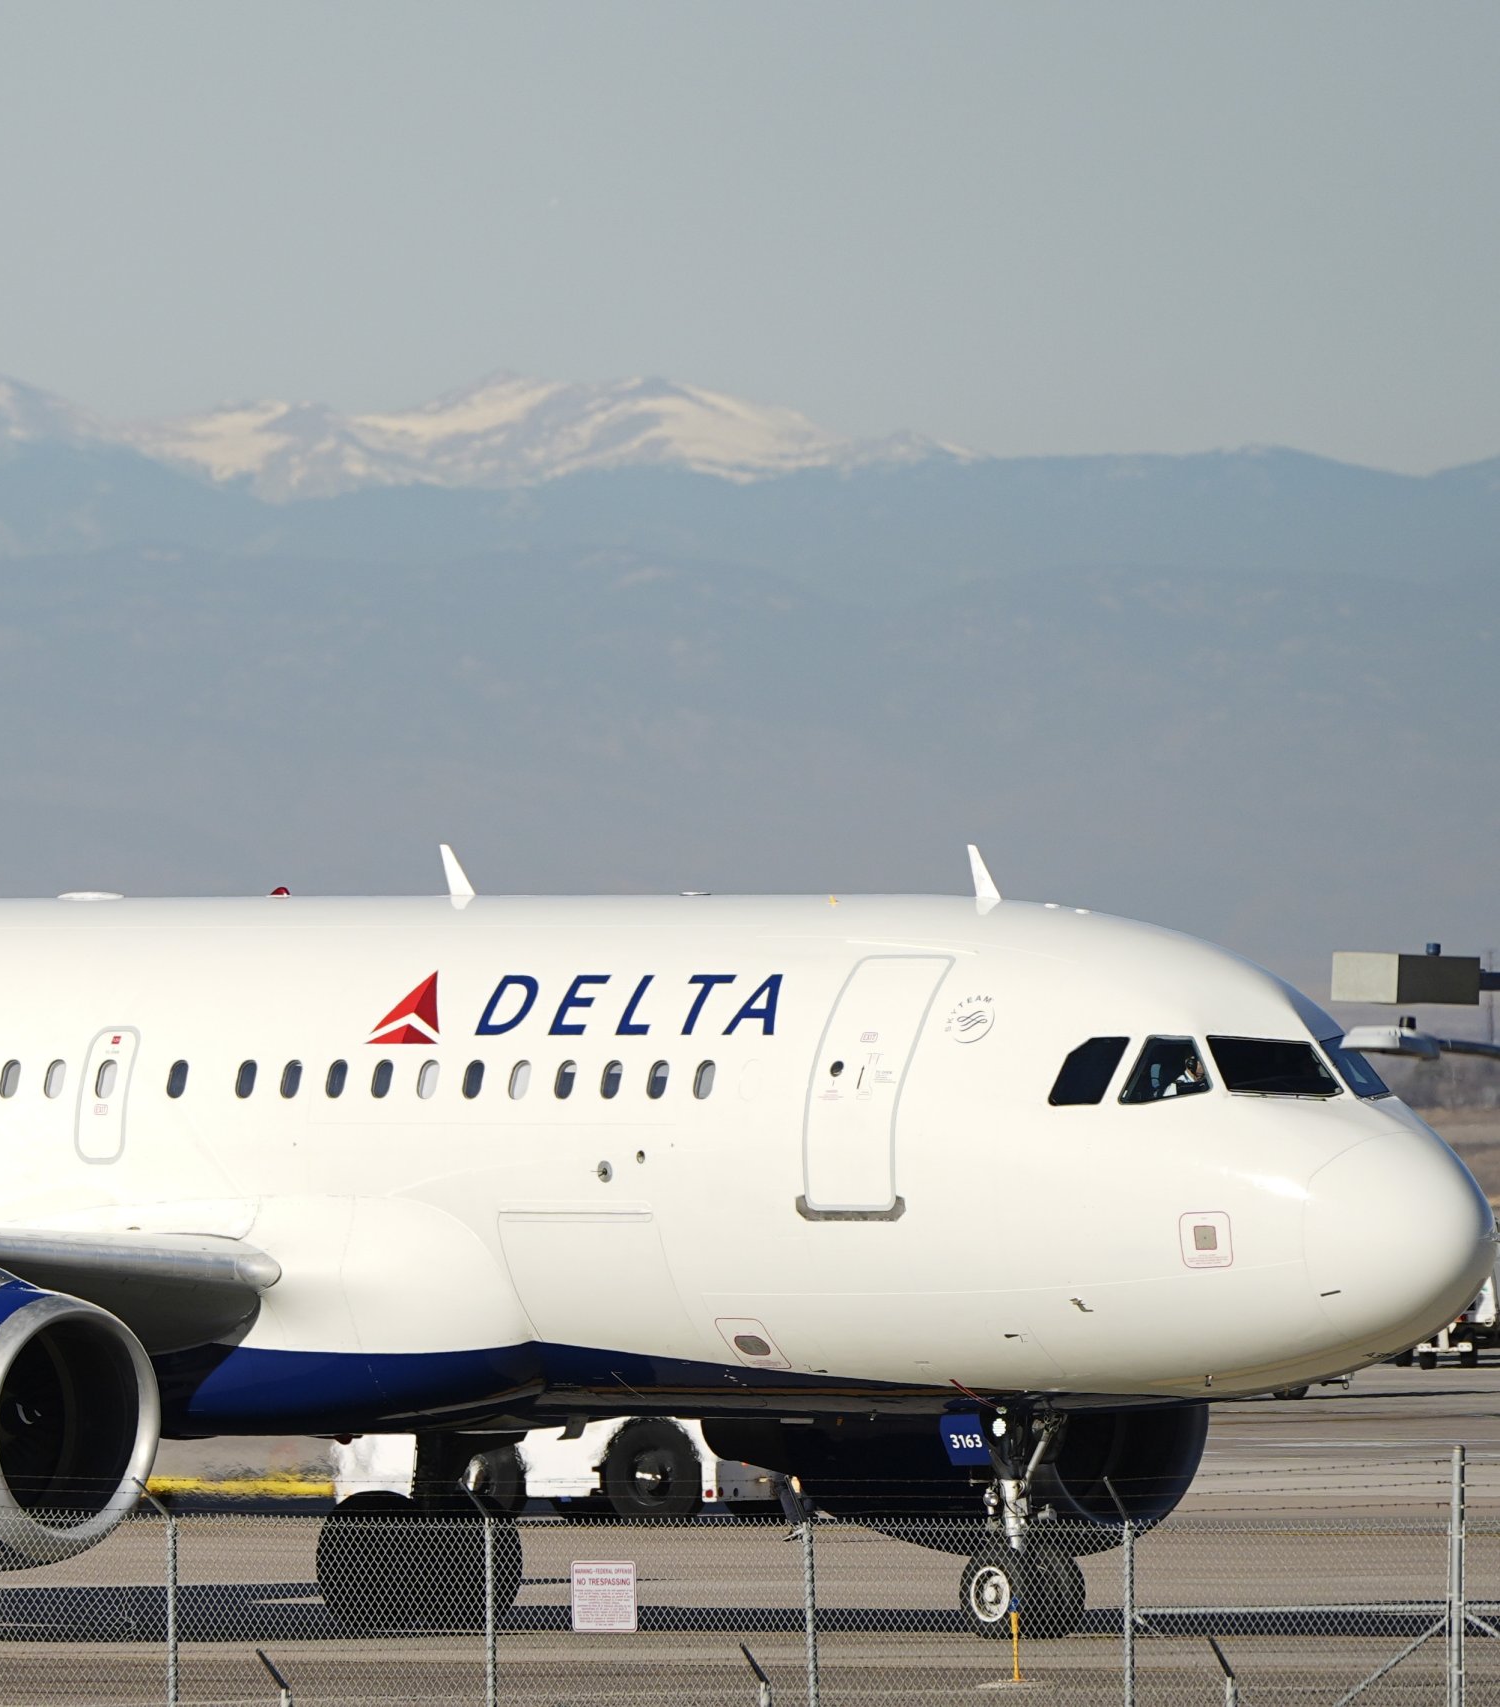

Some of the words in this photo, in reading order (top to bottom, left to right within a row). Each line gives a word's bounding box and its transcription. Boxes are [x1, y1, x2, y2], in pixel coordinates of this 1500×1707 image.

[474, 973, 784, 1036] DELTA
[944, 994, 993, 1032] SKYTEAM
[949, 1433, 983, 1449] 3163
[577, 1578, 587, 1586] NO
[588, 1578, 631, 1586] TRESPASSING
